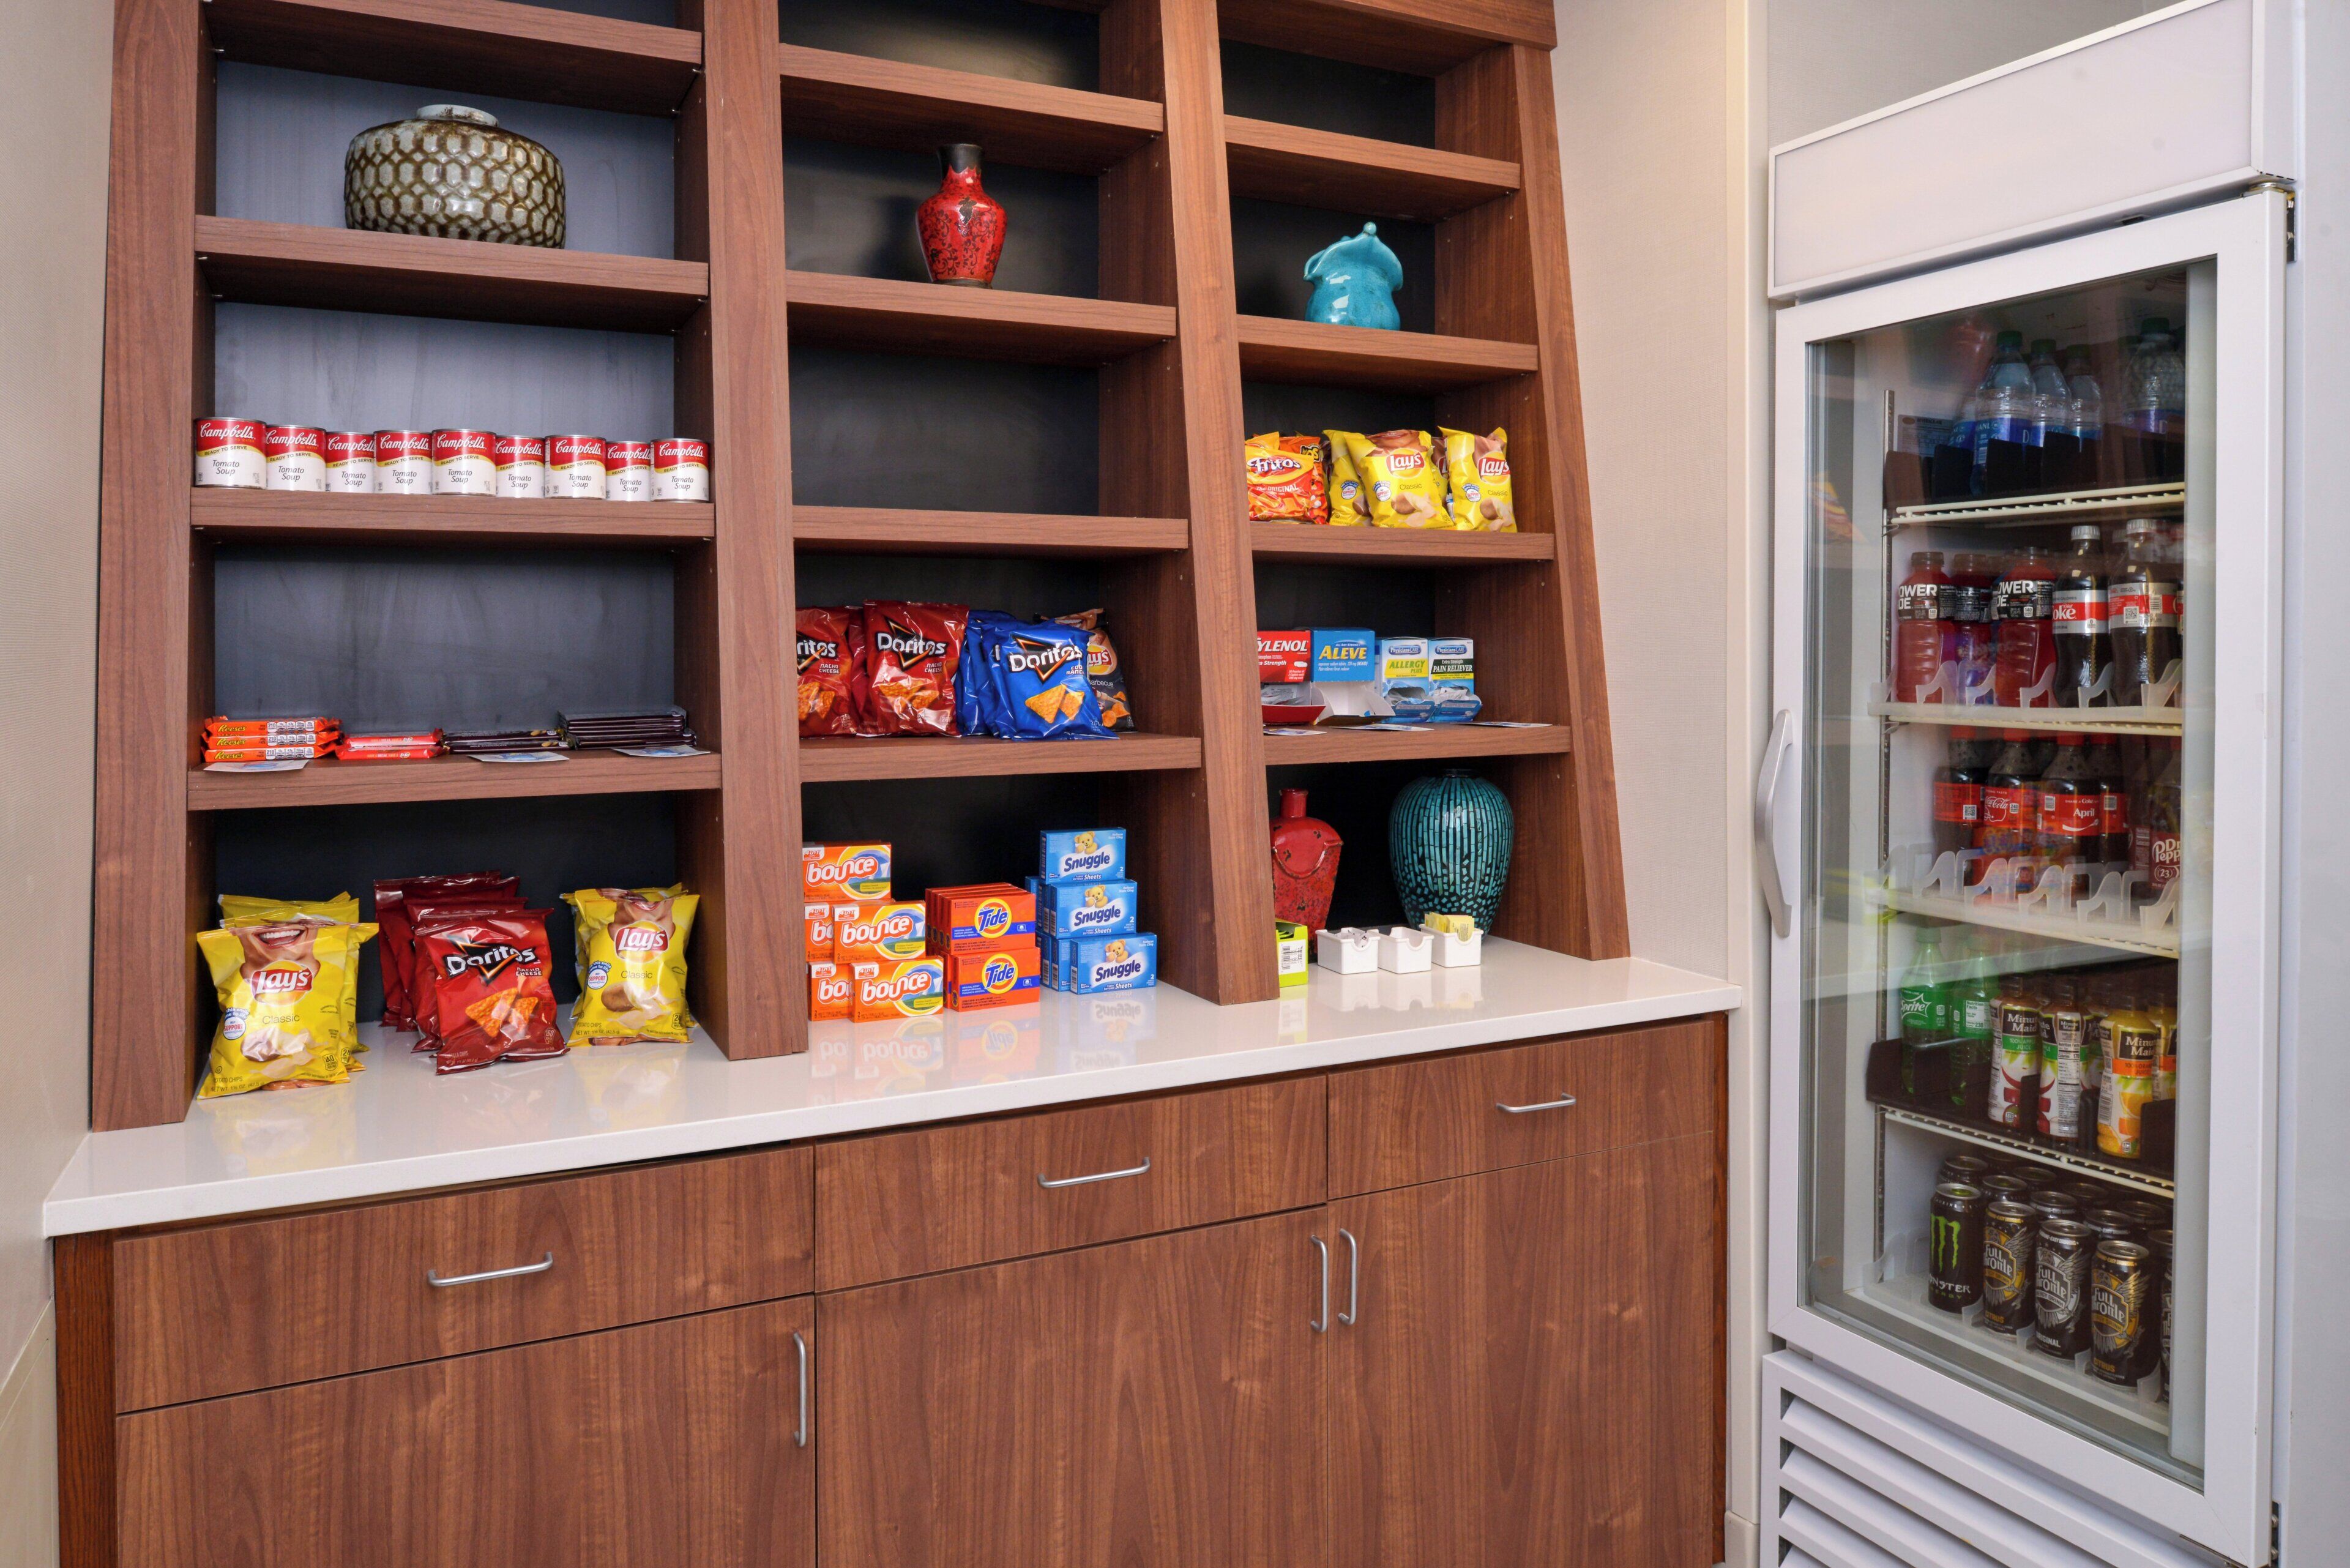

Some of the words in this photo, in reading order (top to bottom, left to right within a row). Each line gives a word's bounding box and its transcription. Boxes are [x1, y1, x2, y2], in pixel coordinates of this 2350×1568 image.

[200, 422, 254, 439] Campbell's
[266, 430, 318, 446] Campbell's
[381, 435, 428, 451] Campbell's
[437, 434, 485, 450] Campbell's
[496, 441, 542, 456] Campbell's
[556, 439, 602, 455] Campbell's
[659, 443, 704, 458] Campbell's
[1247, 458, 1300, 474] Fritos
[1390, 455, 1422, 471] Lay's
[216, 467, 236, 476] Soup
[282, 473, 300, 482] Soup
[345, 479, 362, 487] Soup
[511, 481, 528, 490] Soup
[1268, 483, 1299, 492] ORIGINAL
[1900, 584, 1938, 597] OWER
[2053, 605, 2076, 620] oke
[797, 640, 836, 657] ritos
[878, 633, 946, 655] Doritos
[1257, 638, 1307, 652] YLENOL
[1010, 643, 1082, 672] Doritos
[1318, 645, 1367, 660] ALEVE
[2073, 808, 2095, 819] April
[1064, 851, 1110, 872] Snuggle
[807, 857, 876, 883] bounce
[2160, 869, 2170, 878] 23
[978, 907, 1009, 932] Tide
[1074, 905, 1121, 927] Snuggle
[842, 917, 911, 944] bounce
[618, 928, 665, 951] Lay's
[447, 946, 535, 977] Doritos
[621, 970, 652, 979] Classic
[985, 963, 1015, 988] Tide
[1095, 960, 1141, 982] Snuggle
[256, 969, 311, 995] Lay's
[862, 973, 928, 1001] bounce
[1901, 1000, 1925, 1012] Sprite
[262, 1014, 300, 1025] Classic
[1930, 1273, 1971, 1294] ONSTER
[2048, 1294, 2065, 1309] DRINK
